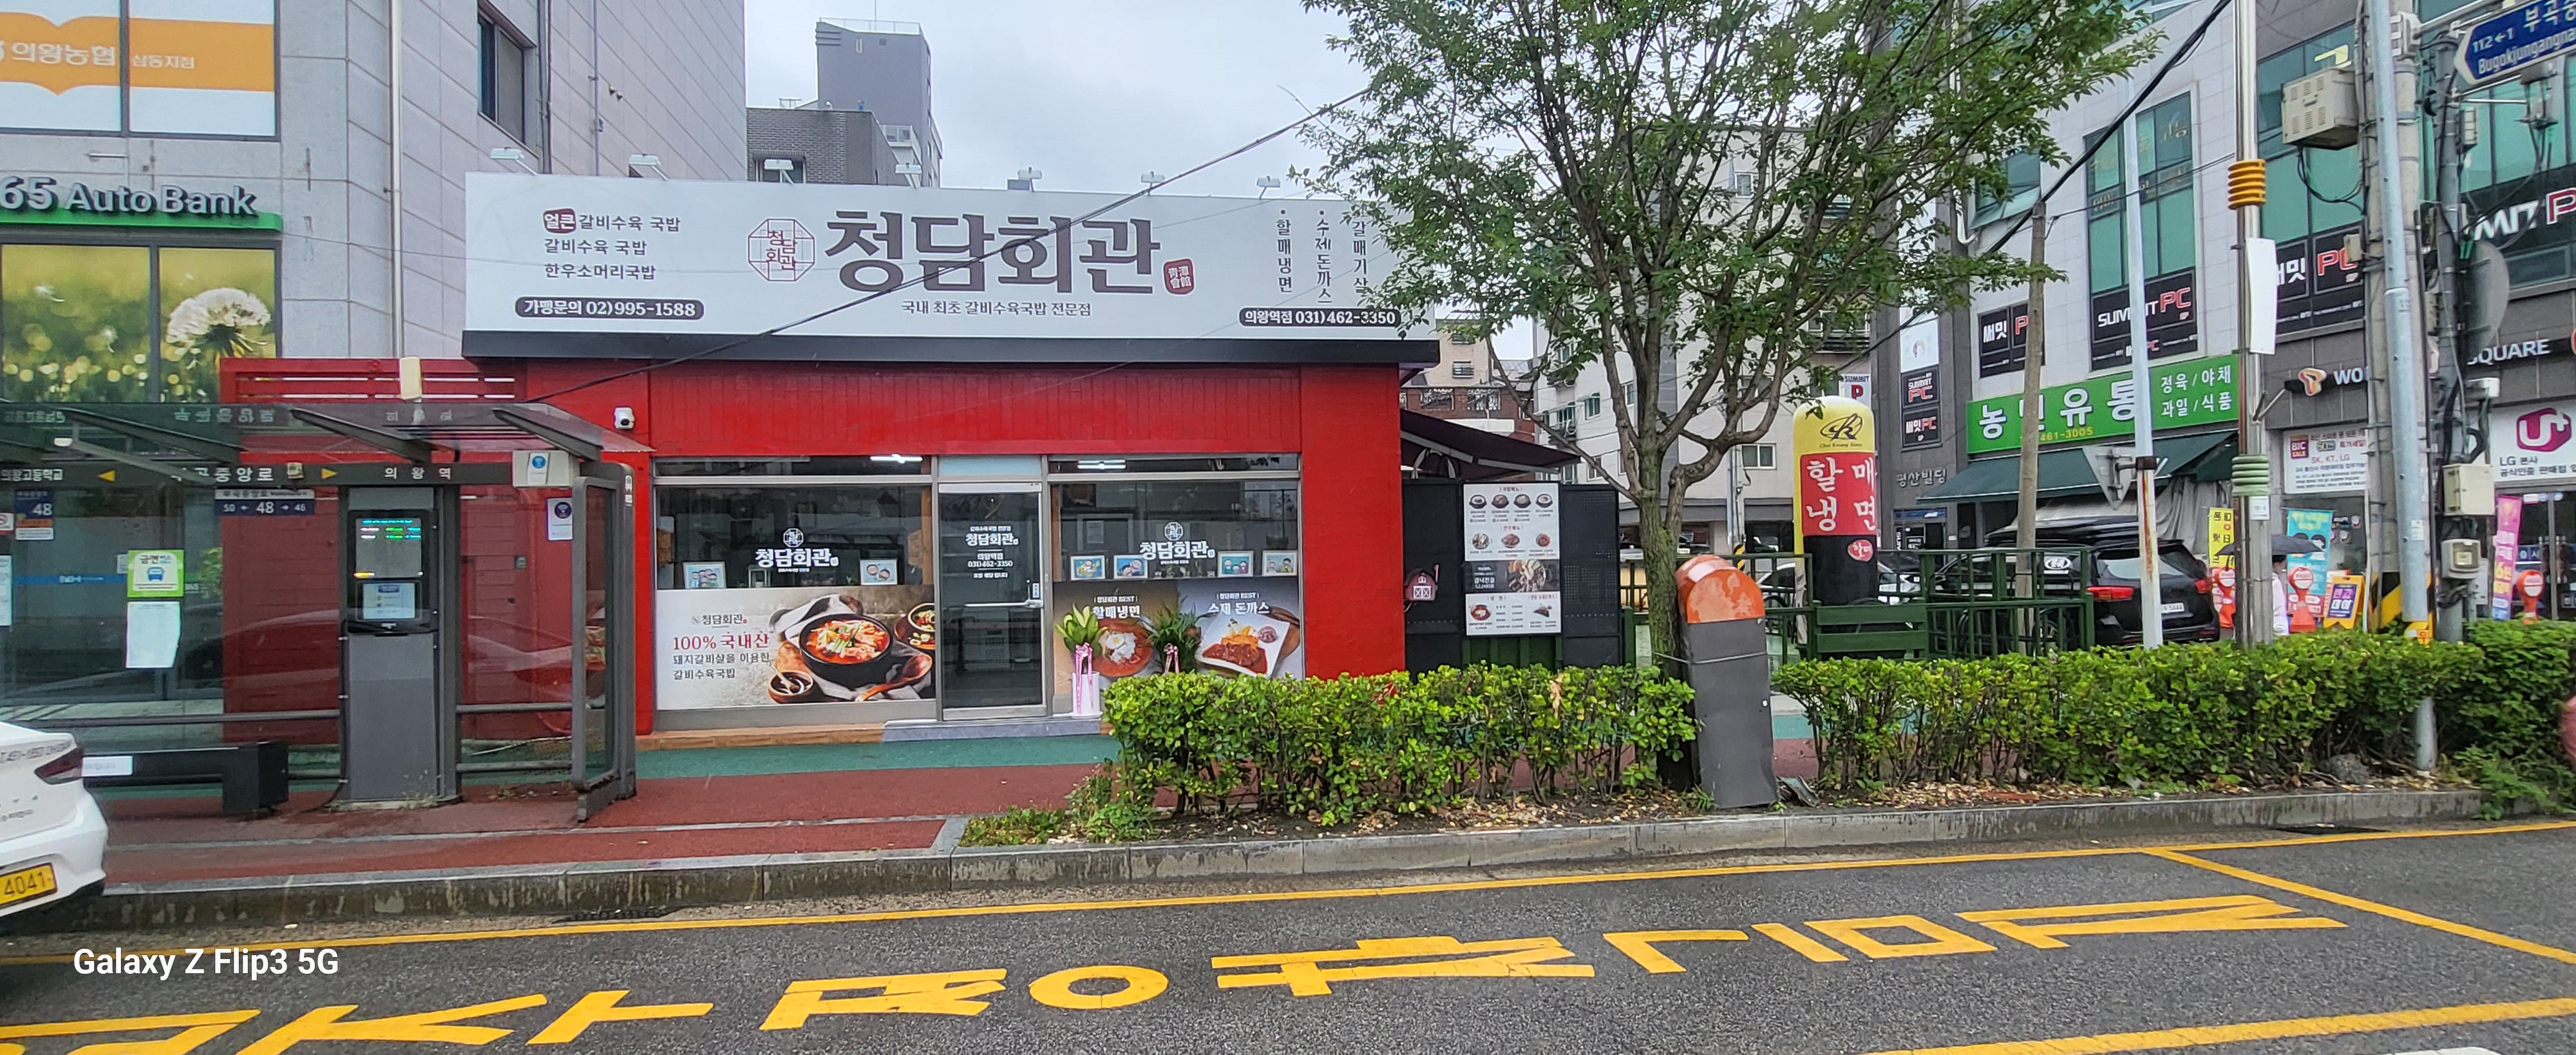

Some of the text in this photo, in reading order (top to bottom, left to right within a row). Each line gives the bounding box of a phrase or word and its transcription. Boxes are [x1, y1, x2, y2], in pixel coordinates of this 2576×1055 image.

[2472, 35, 2493, 53] 112
[12, 42, 116, 66] 의왕농협
[133, 55, 194, 69] 삼동지점
[65, 183, 153, 213] Auto
[160, 185, 257, 215] Bank
[544, 213, 681, 233] 얼큰 갈비수육 국밥
[544, 238, 647, 256] 갈비수육 국밥
[824, 211, 1160, 294] 청담회관
[1276, 219, 1292, 293] 할매냉면
[1315, 218, 1332, 303] 수제돈까스
[1352, 221, 1368, 294] 갈매기살
[545, 263, 656, 280] 한우소머리국밥
[524, 299, 696, 317] 가맹문의 02)995-1588
[902, 300, 1092, 316] 국내 최초 갈비수육국밥 전문점
[2098, 287, 2191, 327] SUMIT PC
[1245, 311, 1395, 324] 의왕역점 031)462-3350
[2161, 375, 2188, 394] 정육
[2201, 365, 2231, 387] 야채
[1908, 386, 1933, 403] PC
[2161, 399, 2188, 418] 과일
[2201, 392, 2233, 413] 식품
[2500, 456, 2515, 466] LG
[384, 467, 450, 480] 의왕역
[1806, 457, 1876, 493] 할매
[1896, 468, 1946, 487] 평산빌딩
[32, 503, 52, 516] 48
[256, 501, 274, 513] 48
[1806, 496, 1876, 531] 냉면
[965, 533, 1014, 546] 청담회관
[755, 549, 831, 567] 청담회관
[1140, 541, 1209, 560] 청담회관
[1092, 605, 1140, 619] 할매냉면
[1235, 602, 1270, 614] 돈까스
[702, 614, 743, 625] 청담회관
[674, 632, 770, 650] 100% 국내산
[674, 652, 770, 664] 돼지갈비살을 이용한
[674, 668, 735, 680] 갈비수육국밥
[5, 871, 45, 896] 4041
